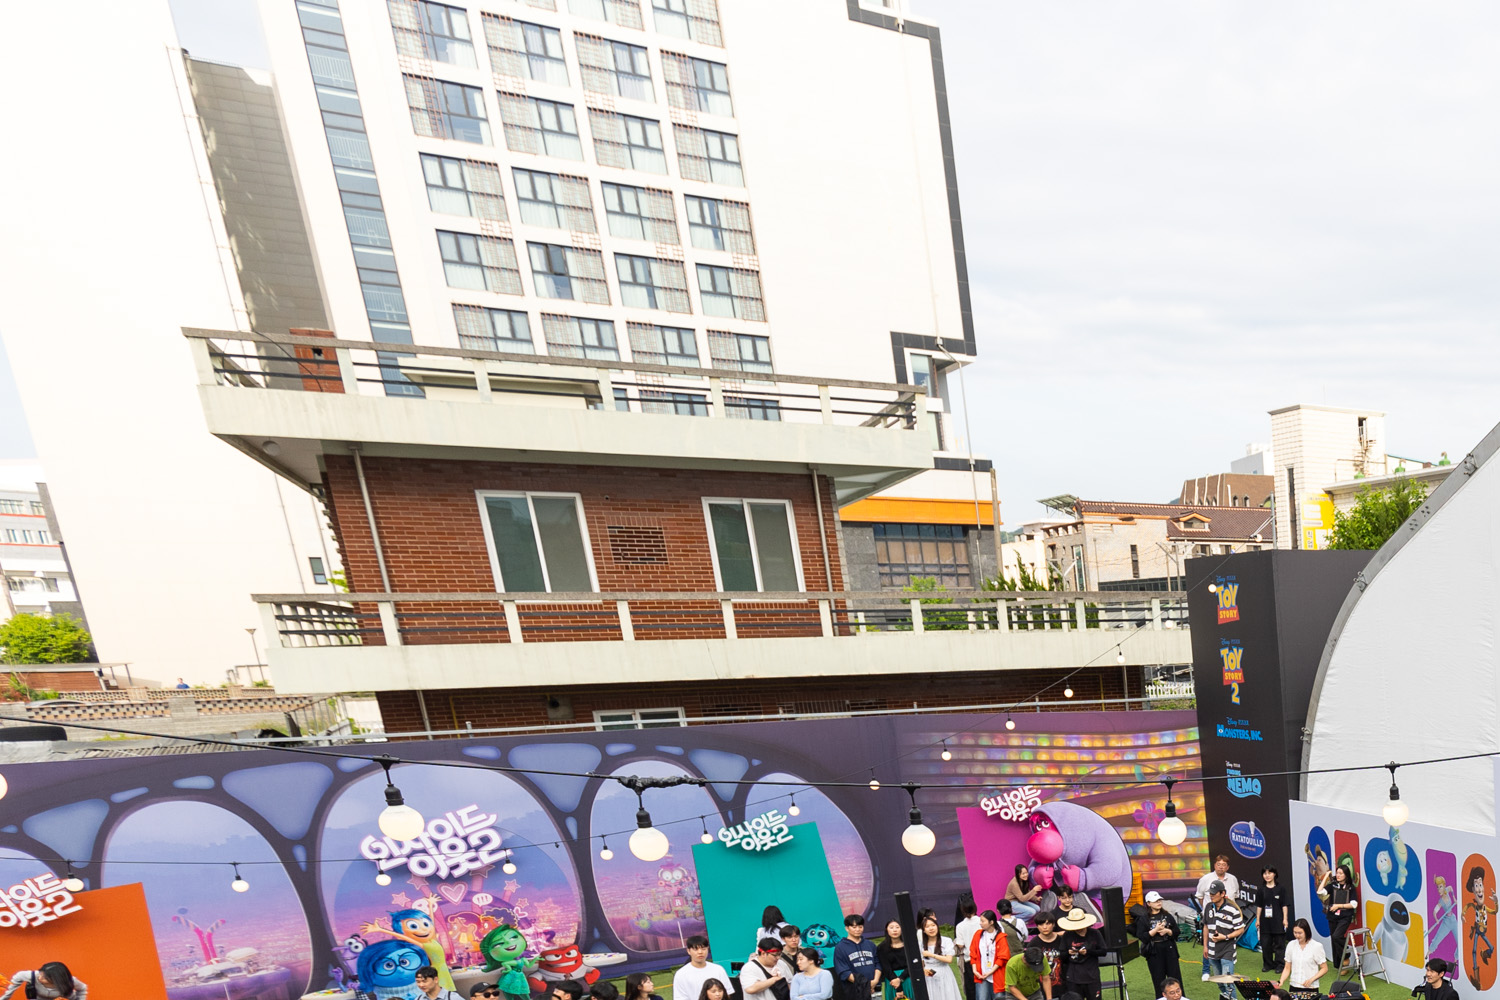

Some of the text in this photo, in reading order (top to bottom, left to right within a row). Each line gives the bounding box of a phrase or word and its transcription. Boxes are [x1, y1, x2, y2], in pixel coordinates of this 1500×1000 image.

[1215, 582, 1239, 610] TOY
[1220, 646, 1244, 672] TOY
[1224, 672, 1242, 681] STORY
[1231, 681, 1240, 705] 2
[1231, 831, 1263, 848] RATATOUILLE
